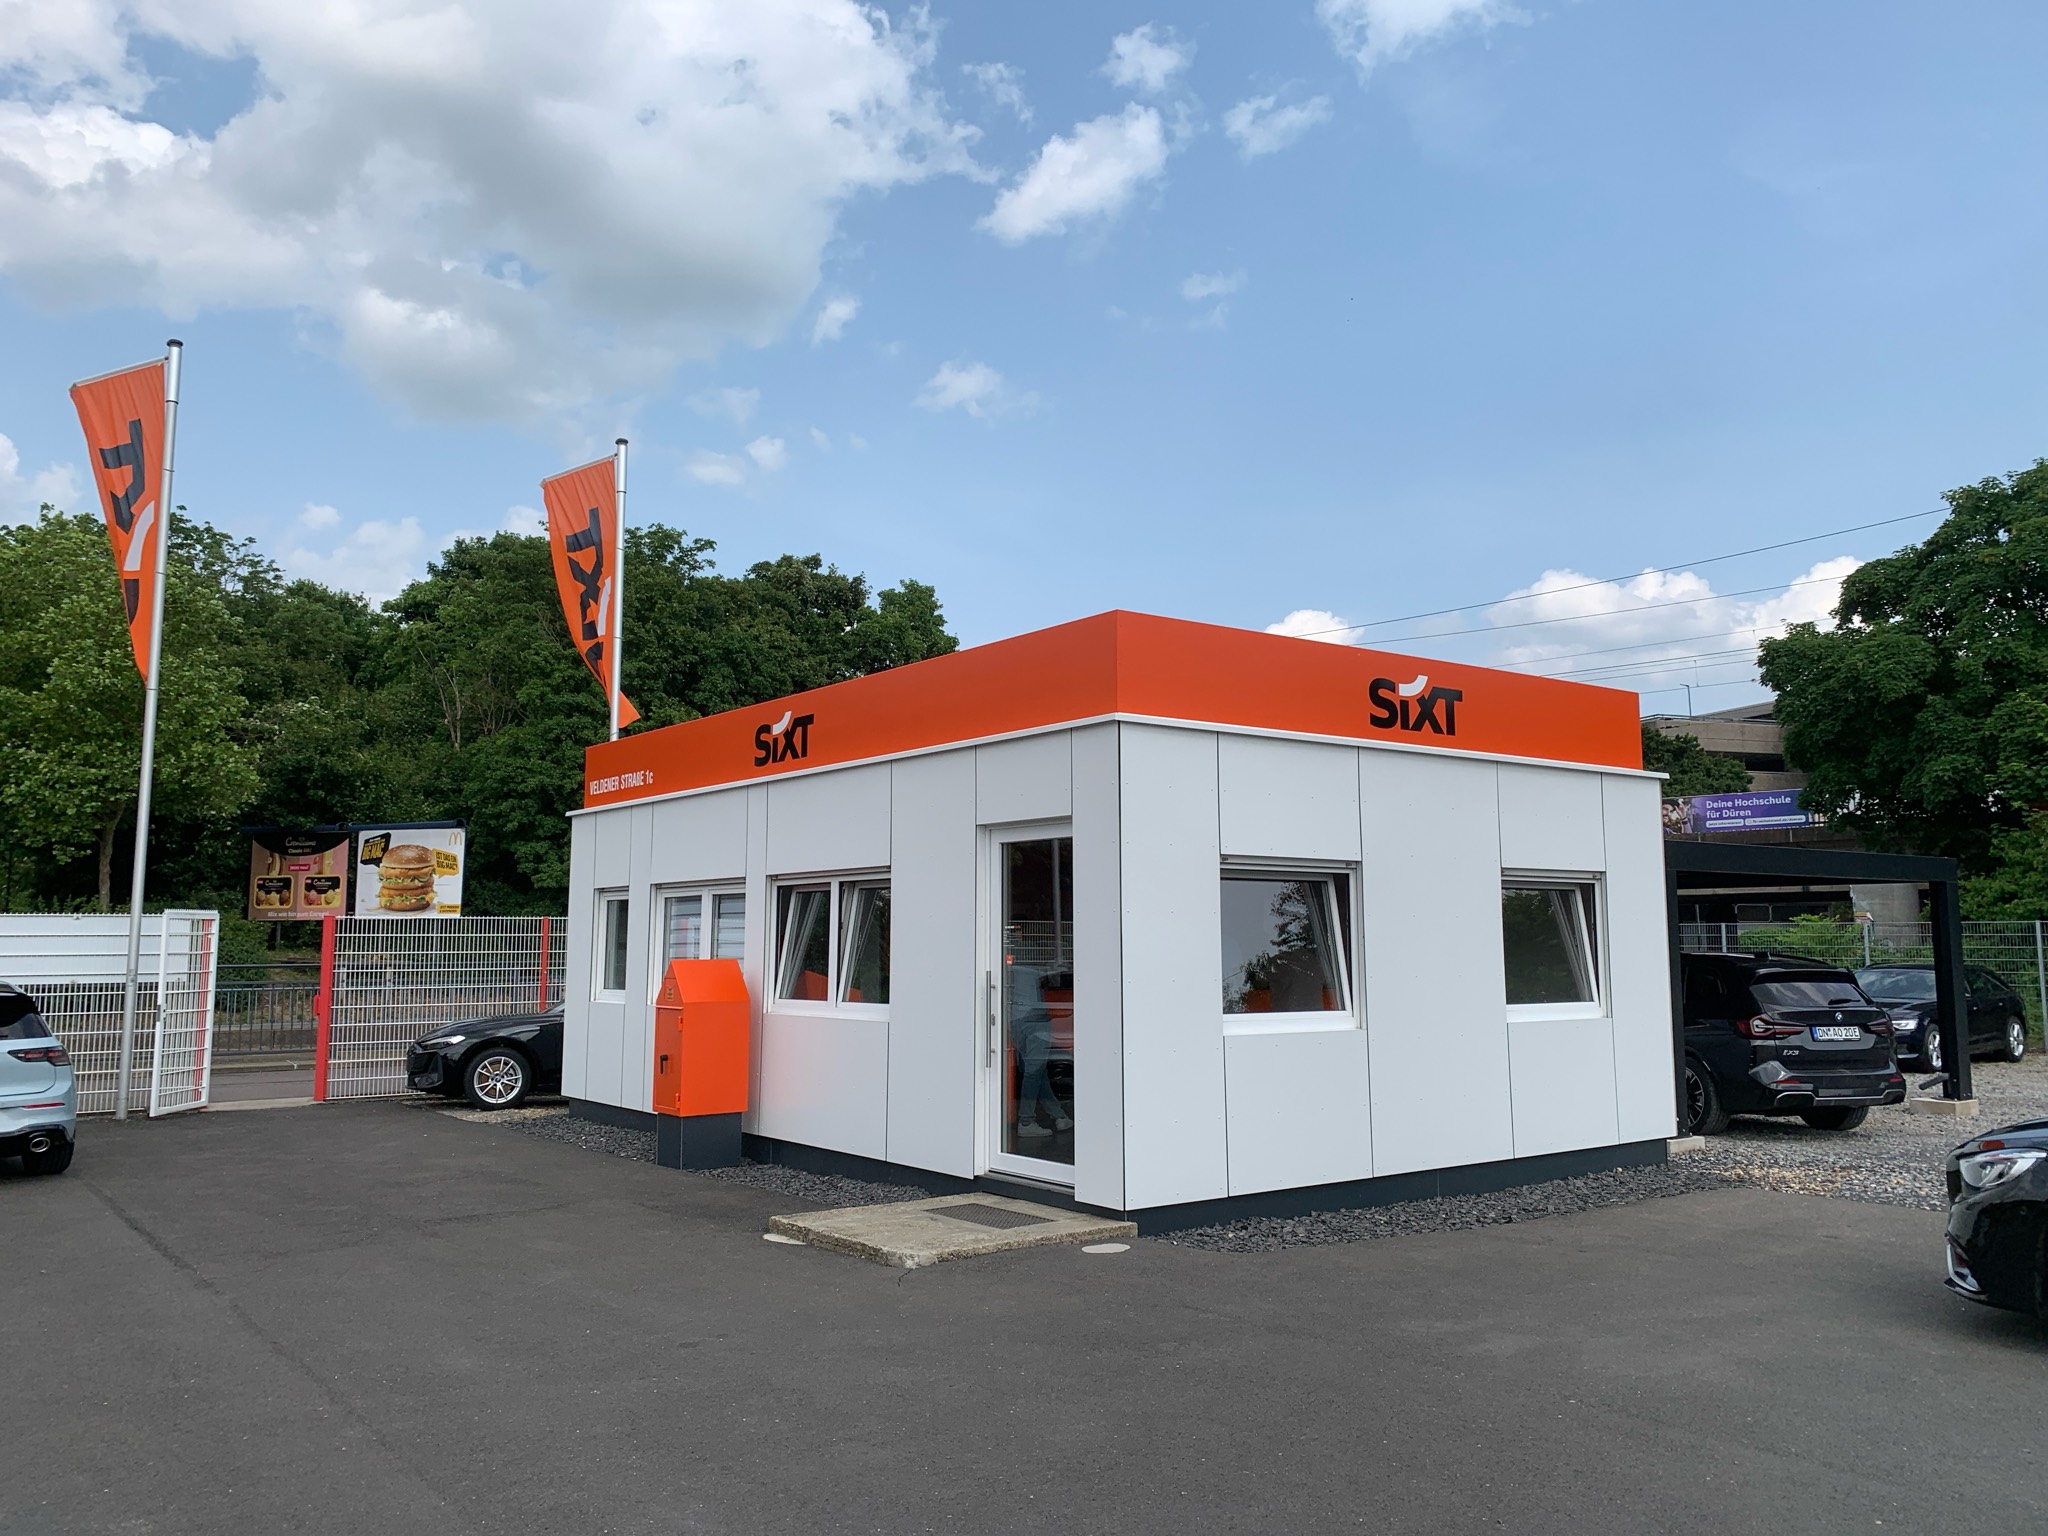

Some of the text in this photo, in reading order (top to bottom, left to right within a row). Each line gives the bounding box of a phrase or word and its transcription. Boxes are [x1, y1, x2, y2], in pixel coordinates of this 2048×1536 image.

[589, 775, 620, 796] VELDENER
[1705, 795, 1792, 809] Deine Hochschule
[1706, 809, 1752, 819] für Düren
[436, 860, 445, 869] BIG
[1817, 1028, 1829, 1038] DN
[1844, 1027, 1859, 1037] 20E
